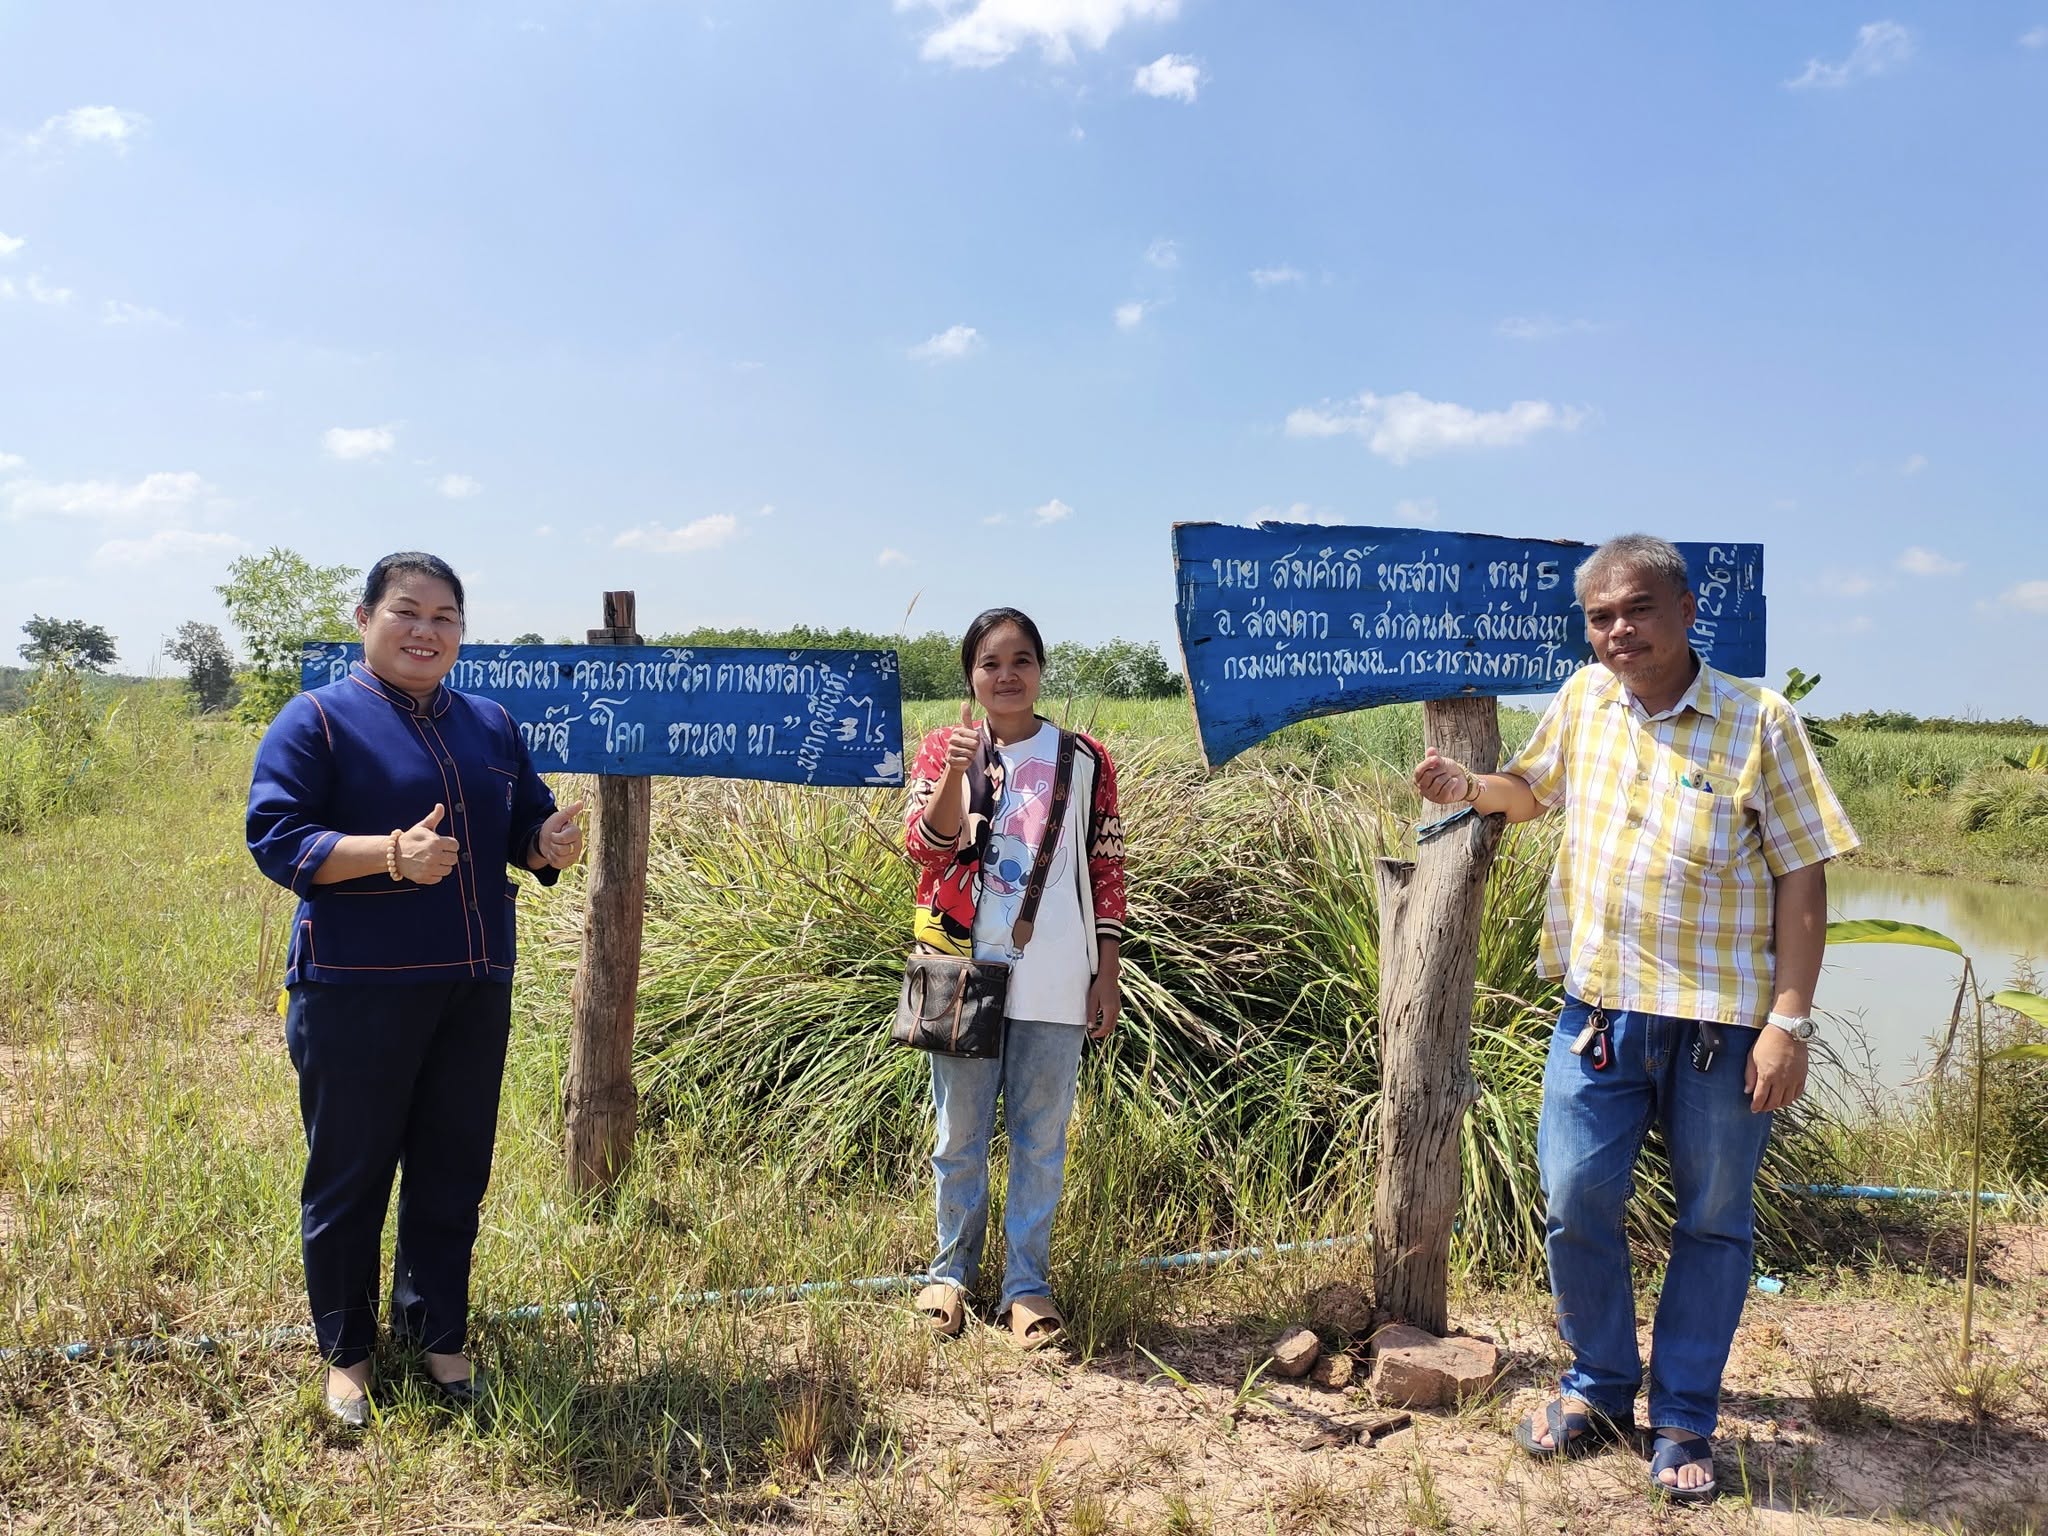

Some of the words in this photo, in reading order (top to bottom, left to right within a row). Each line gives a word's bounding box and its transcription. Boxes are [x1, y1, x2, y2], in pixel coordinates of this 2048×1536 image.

[1212, 558, 1259, 590] นาย
[1270, 544, 1380, 590] สมศักดิ์
[1488, 550, 1530, 604] หมู่
[1536, 560, 1560, 591] 5
[1213, 609, 1236, 636] อ.
[1241, 596, 1329, 640] ส่องดาว
[440, 645, 560, 689] การพัฒนา
[668, 721, 738, 758] หนอง
